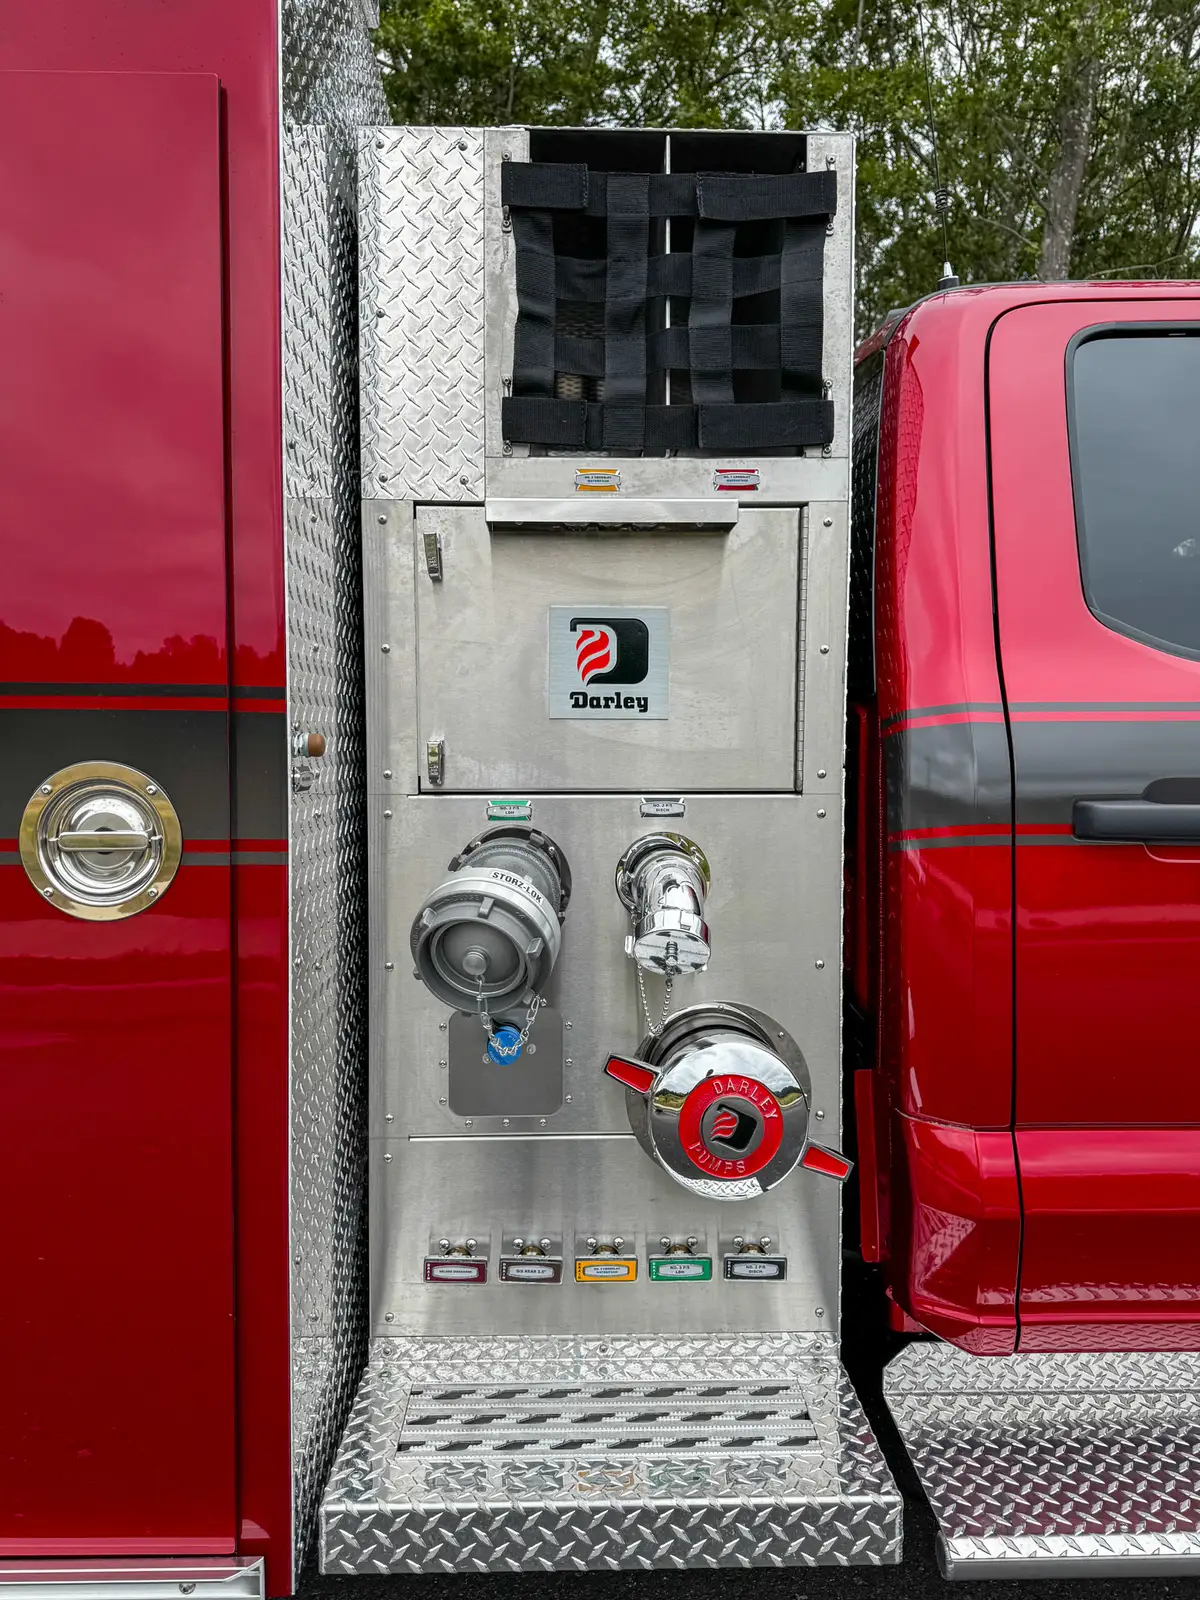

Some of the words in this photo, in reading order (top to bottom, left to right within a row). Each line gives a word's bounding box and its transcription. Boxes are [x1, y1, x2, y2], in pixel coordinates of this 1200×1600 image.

[569, 691, 649, 713] Darley
[491, 871, 543, 904] STORZ-LOK
[712, 1078, 778, 1119] DARLEY
[688, 1141, 746, 1174] PUMPS
